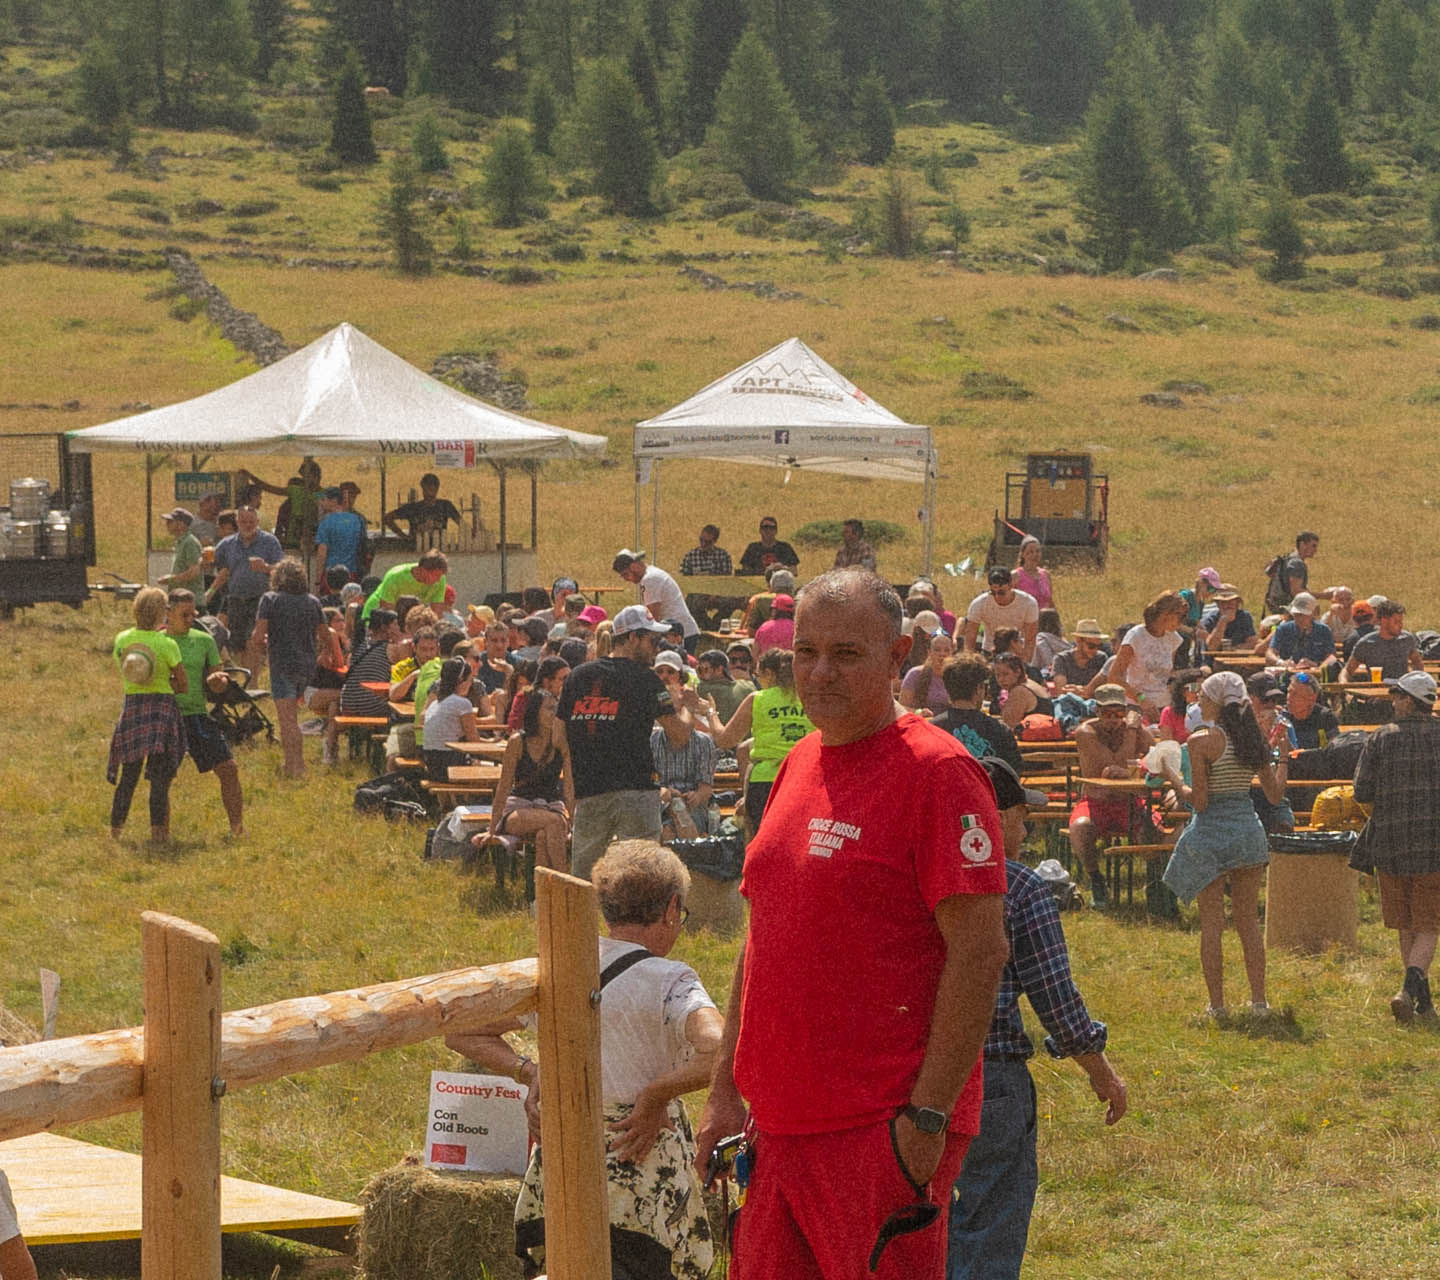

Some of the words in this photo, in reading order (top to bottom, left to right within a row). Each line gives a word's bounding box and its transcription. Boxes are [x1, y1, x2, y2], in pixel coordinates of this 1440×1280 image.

[741, 377, 783, 387] APT
[378, 439, 488, 454] WARSTR
[573, 696, 619, 715] KTM
[831, 821, 862, 841] ROSSA
[435, 1081, 493, 1099] Country
[495, 1086, 521, 1100] Fest
[434, 1109, 458, 1120] Con
[433, 1122, 453, 1132] Old
[456, 1123, 489, 1135] Boots
